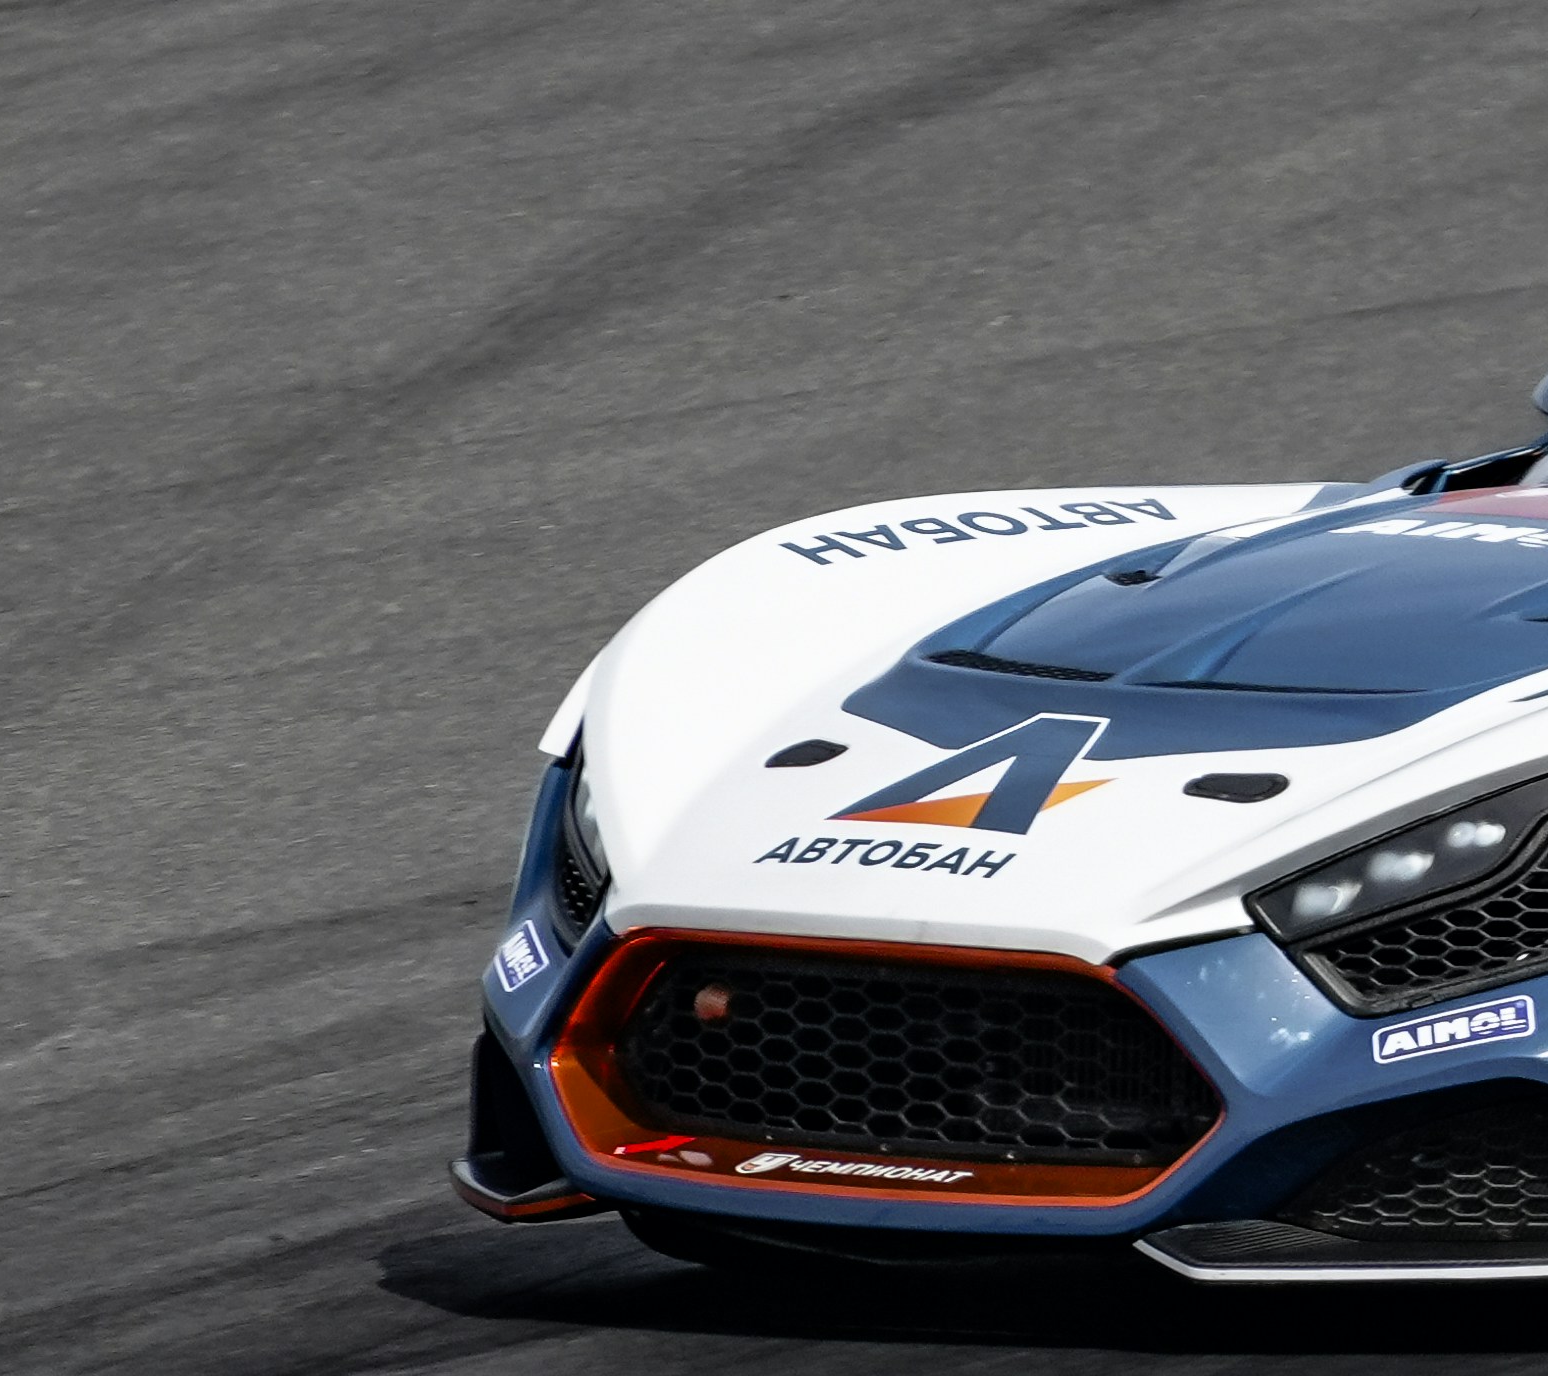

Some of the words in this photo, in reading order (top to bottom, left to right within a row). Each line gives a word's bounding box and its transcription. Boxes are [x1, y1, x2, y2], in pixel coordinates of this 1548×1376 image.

[779, 497, 1177, 565] АВТОБАН
[752, 836, 1018, 879] АВТОБАН
[1381, 1006, 1527, 1057] AIMOL
[789, 1157, 975, 1184] ЧЕМПИОНАТ
